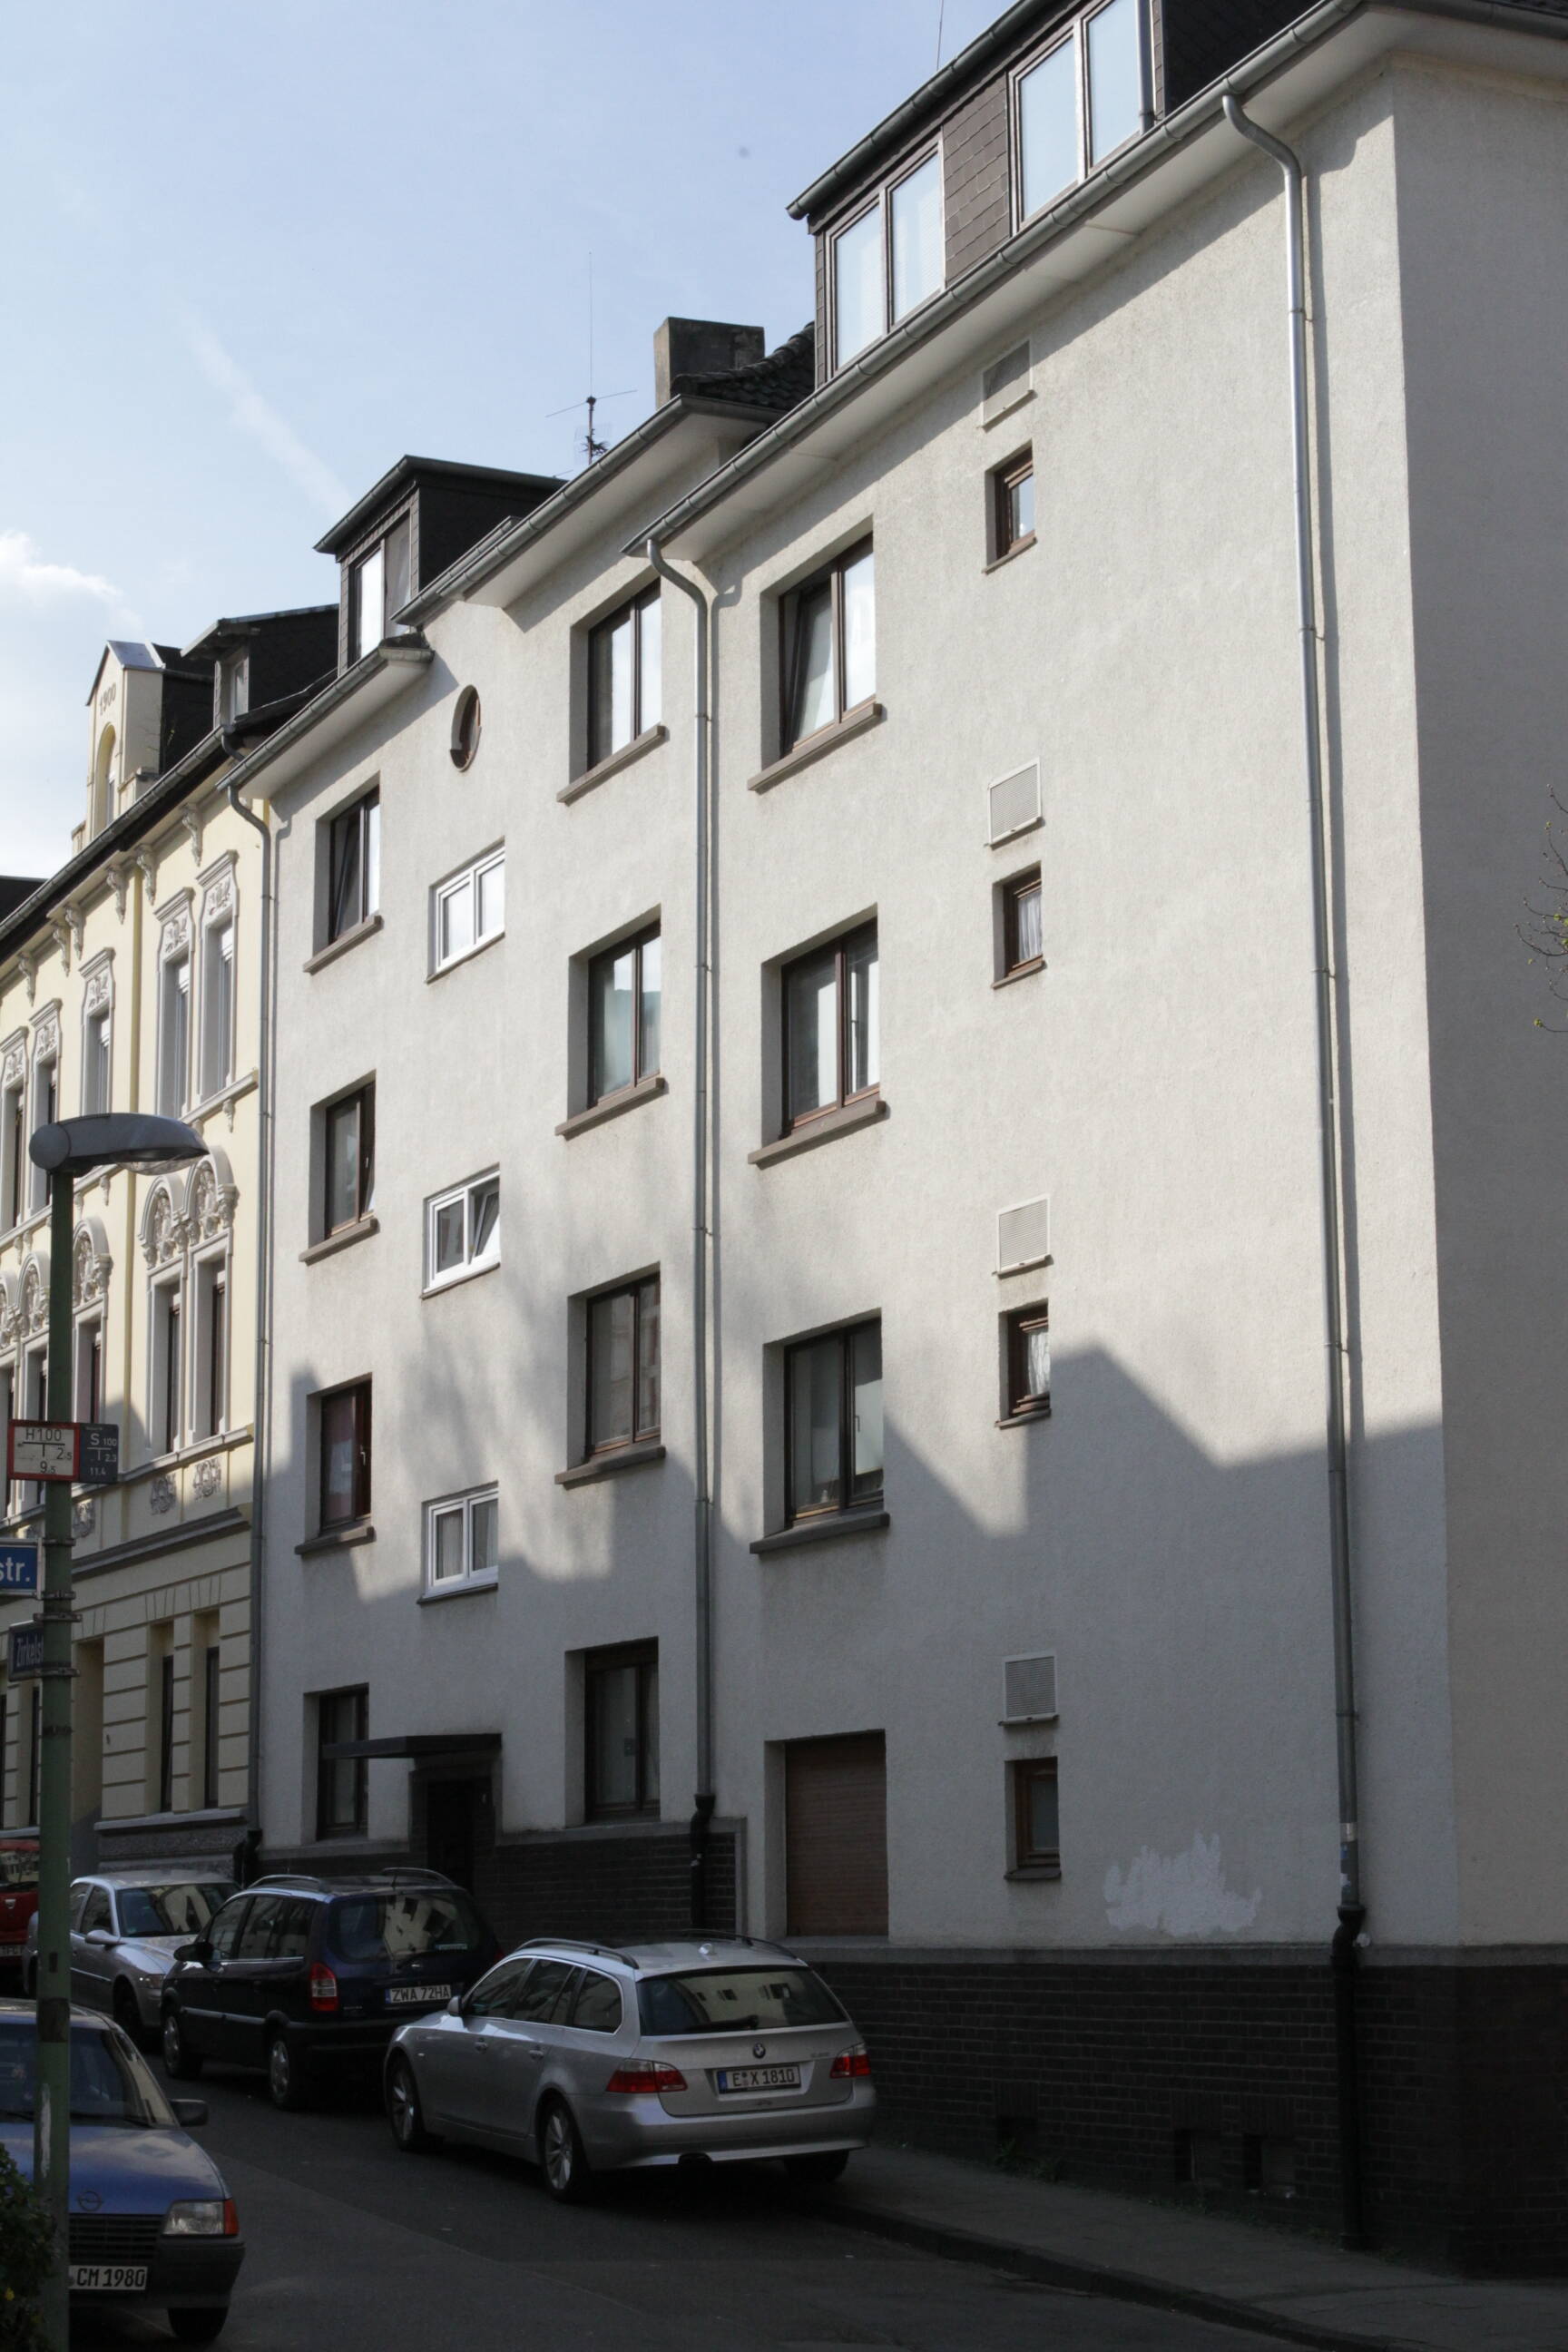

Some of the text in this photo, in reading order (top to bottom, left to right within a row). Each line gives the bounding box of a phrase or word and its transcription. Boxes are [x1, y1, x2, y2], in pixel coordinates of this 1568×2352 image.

[90, 1433, 100, 1446] S
[732, 2073, 741, 2086] E
[762, 2069, 795, 2084] 1810
[76, 2268, 145, 2287] CM 1980
